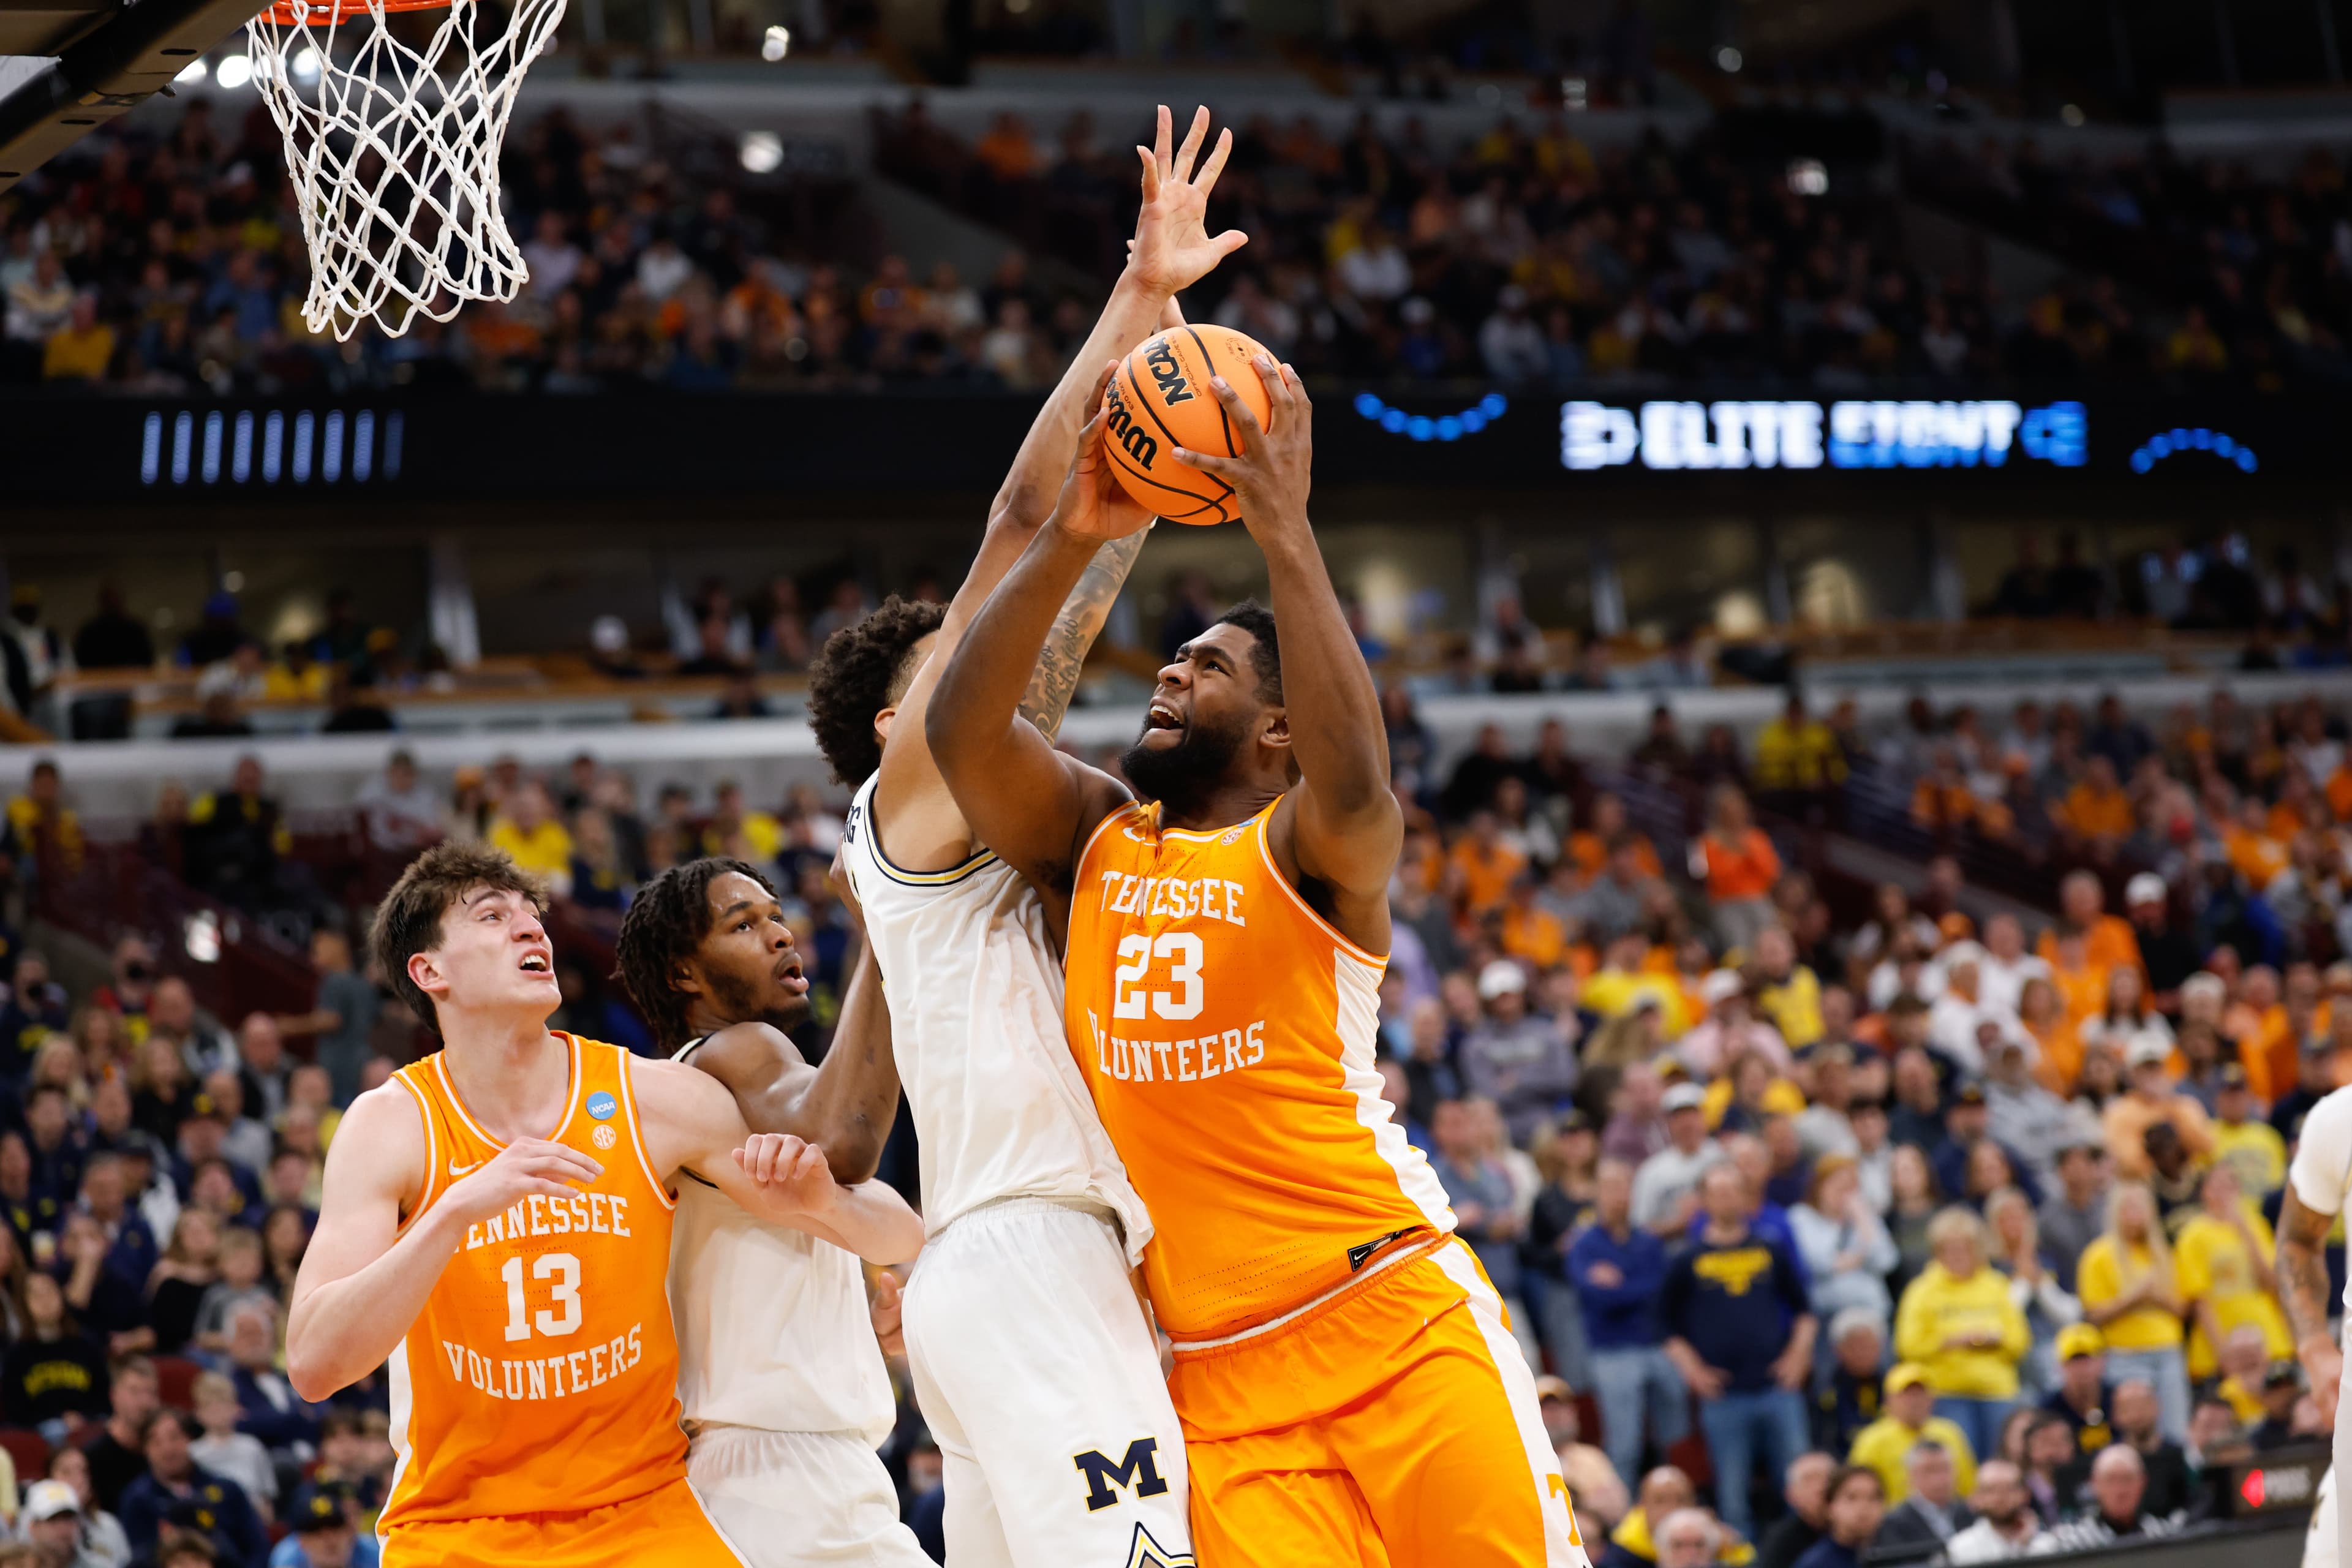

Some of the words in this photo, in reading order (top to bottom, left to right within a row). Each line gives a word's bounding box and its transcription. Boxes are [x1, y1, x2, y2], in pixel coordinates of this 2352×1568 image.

[1143, 336, 1194, 407] NCAA
[1640, 401, 1824, 469] ELITE
[1113, 932, 1204, 1020] 23
[1087, 1007, 1265, 1082] VLUNTEERS
[591, 1101, 616, 1115] NCAA
[594, 1126, 615, 1148] SEC
[454, 1193, 631, 1254] ENNESSEE
[501, 1253, 582, 1342] 13
[442, 1322, 641, 1400] VOLUNTEERS
[1072, 1436, 1170, 1513] M
